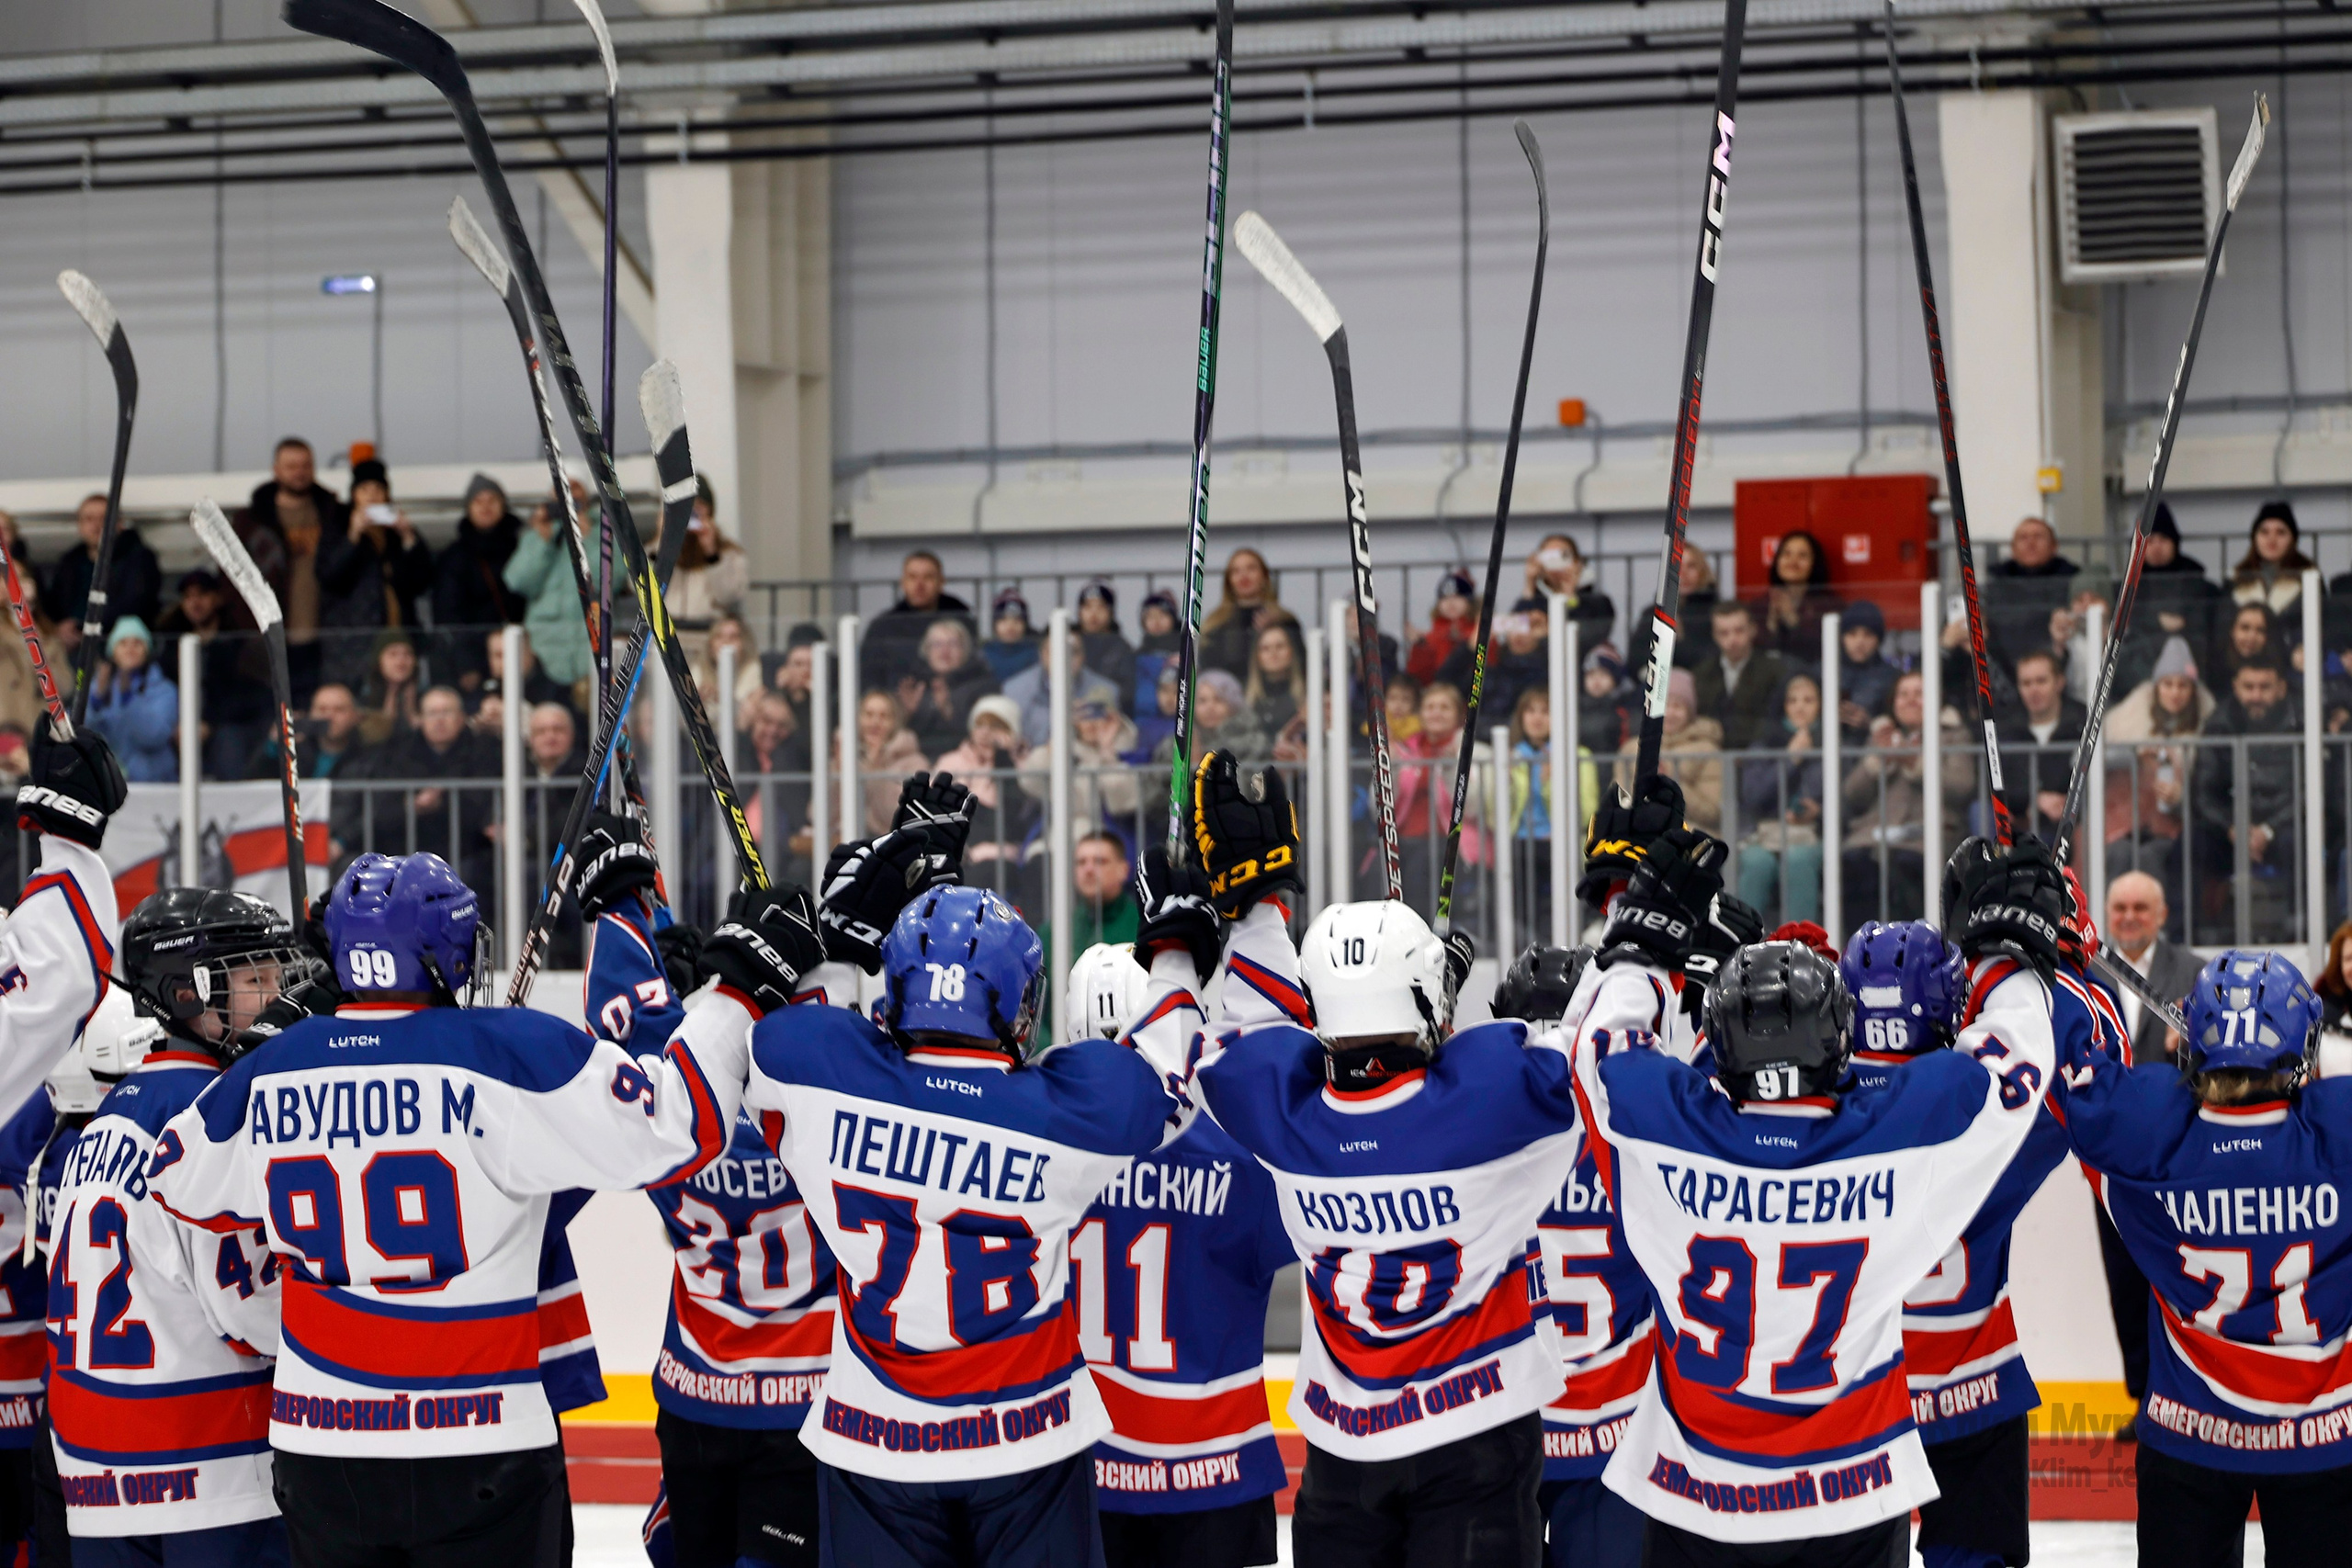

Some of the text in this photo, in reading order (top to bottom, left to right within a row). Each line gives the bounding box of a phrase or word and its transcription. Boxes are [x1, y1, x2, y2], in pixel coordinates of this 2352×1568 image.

[1701, 110, 1736, 286] CCM
[1197, 326, 1212, 394] BAUER
[1187, 461, 1214, 634] BAUER
[1346, 469, 1376, 614] CCM
[1962, 565, 1993, 698] JETSPEED
[2084, 660, 2116, 754] JETSPEED
[729, 805, 770, 890] SUPER
[153, 935, 196, 953] BAUER
[348, 949, 398, 989] 99
[1341, 937, 1364, 965] 10
[925, 963, 966, 1002] 78
[1098, 992, 1114, 1019] 11
[328, 1033, 381, 1048] LUTCH
[1864, 1017, 1908, 1051] 66
[2222, 1007, 2256, 1048] 71
[925, 1076, 983, 1098] LUTCH
[1755, 1066, 1800, 1100] 97
[251, 1077, 422, 1148] АВУДОВ
[1339, 1140, 1378, 1154] LUTCH
[1755, 1134, 1799, 1149] LUTCH
[2212, 1138, 2262, 1154] LUTCH
[685, 1156, 788, 1199] ЮСЕВ
[1100, 1159, 1232, 1217] НСКИЙ
[1657, 1161, 1895, 1224] ТАРАСЕВИЧ
[265, 1149, 469, 1294] 99
[1295, 1183, 1461, 1235] КОЗЛОВ
[672, 1190, 817, 1312] 20
[831, 1179, 1042, 1349] 78
[47, 1196, 154, 1370] 42
[1069, 1217, 1177, 1371] 11
[1311, 1236, 1464, 1332] 10
[2177, 1241, 2323, 1346] 71
[1671, 1232, 1869, 1394] 97
[413, 1392, 504, 1429] ОКРУГ
[761, 1372, 828, 1406] ОКРУ
[1424, 1358, 1505, 1416] ОКРУГ
[1939, 1372, 1999, 1418] ОКРУГ
[1001, 1387, 1072, 1443] ОКРУГ
[2300, 1407, 2352, 1448] ОКРУ
[120, 1467, 199, 1506] ОКРУГ
[1171, 1451, 1240, 1492] ОКРУГ
[1819, 1449, 1894, 1504] ОКРУГ
